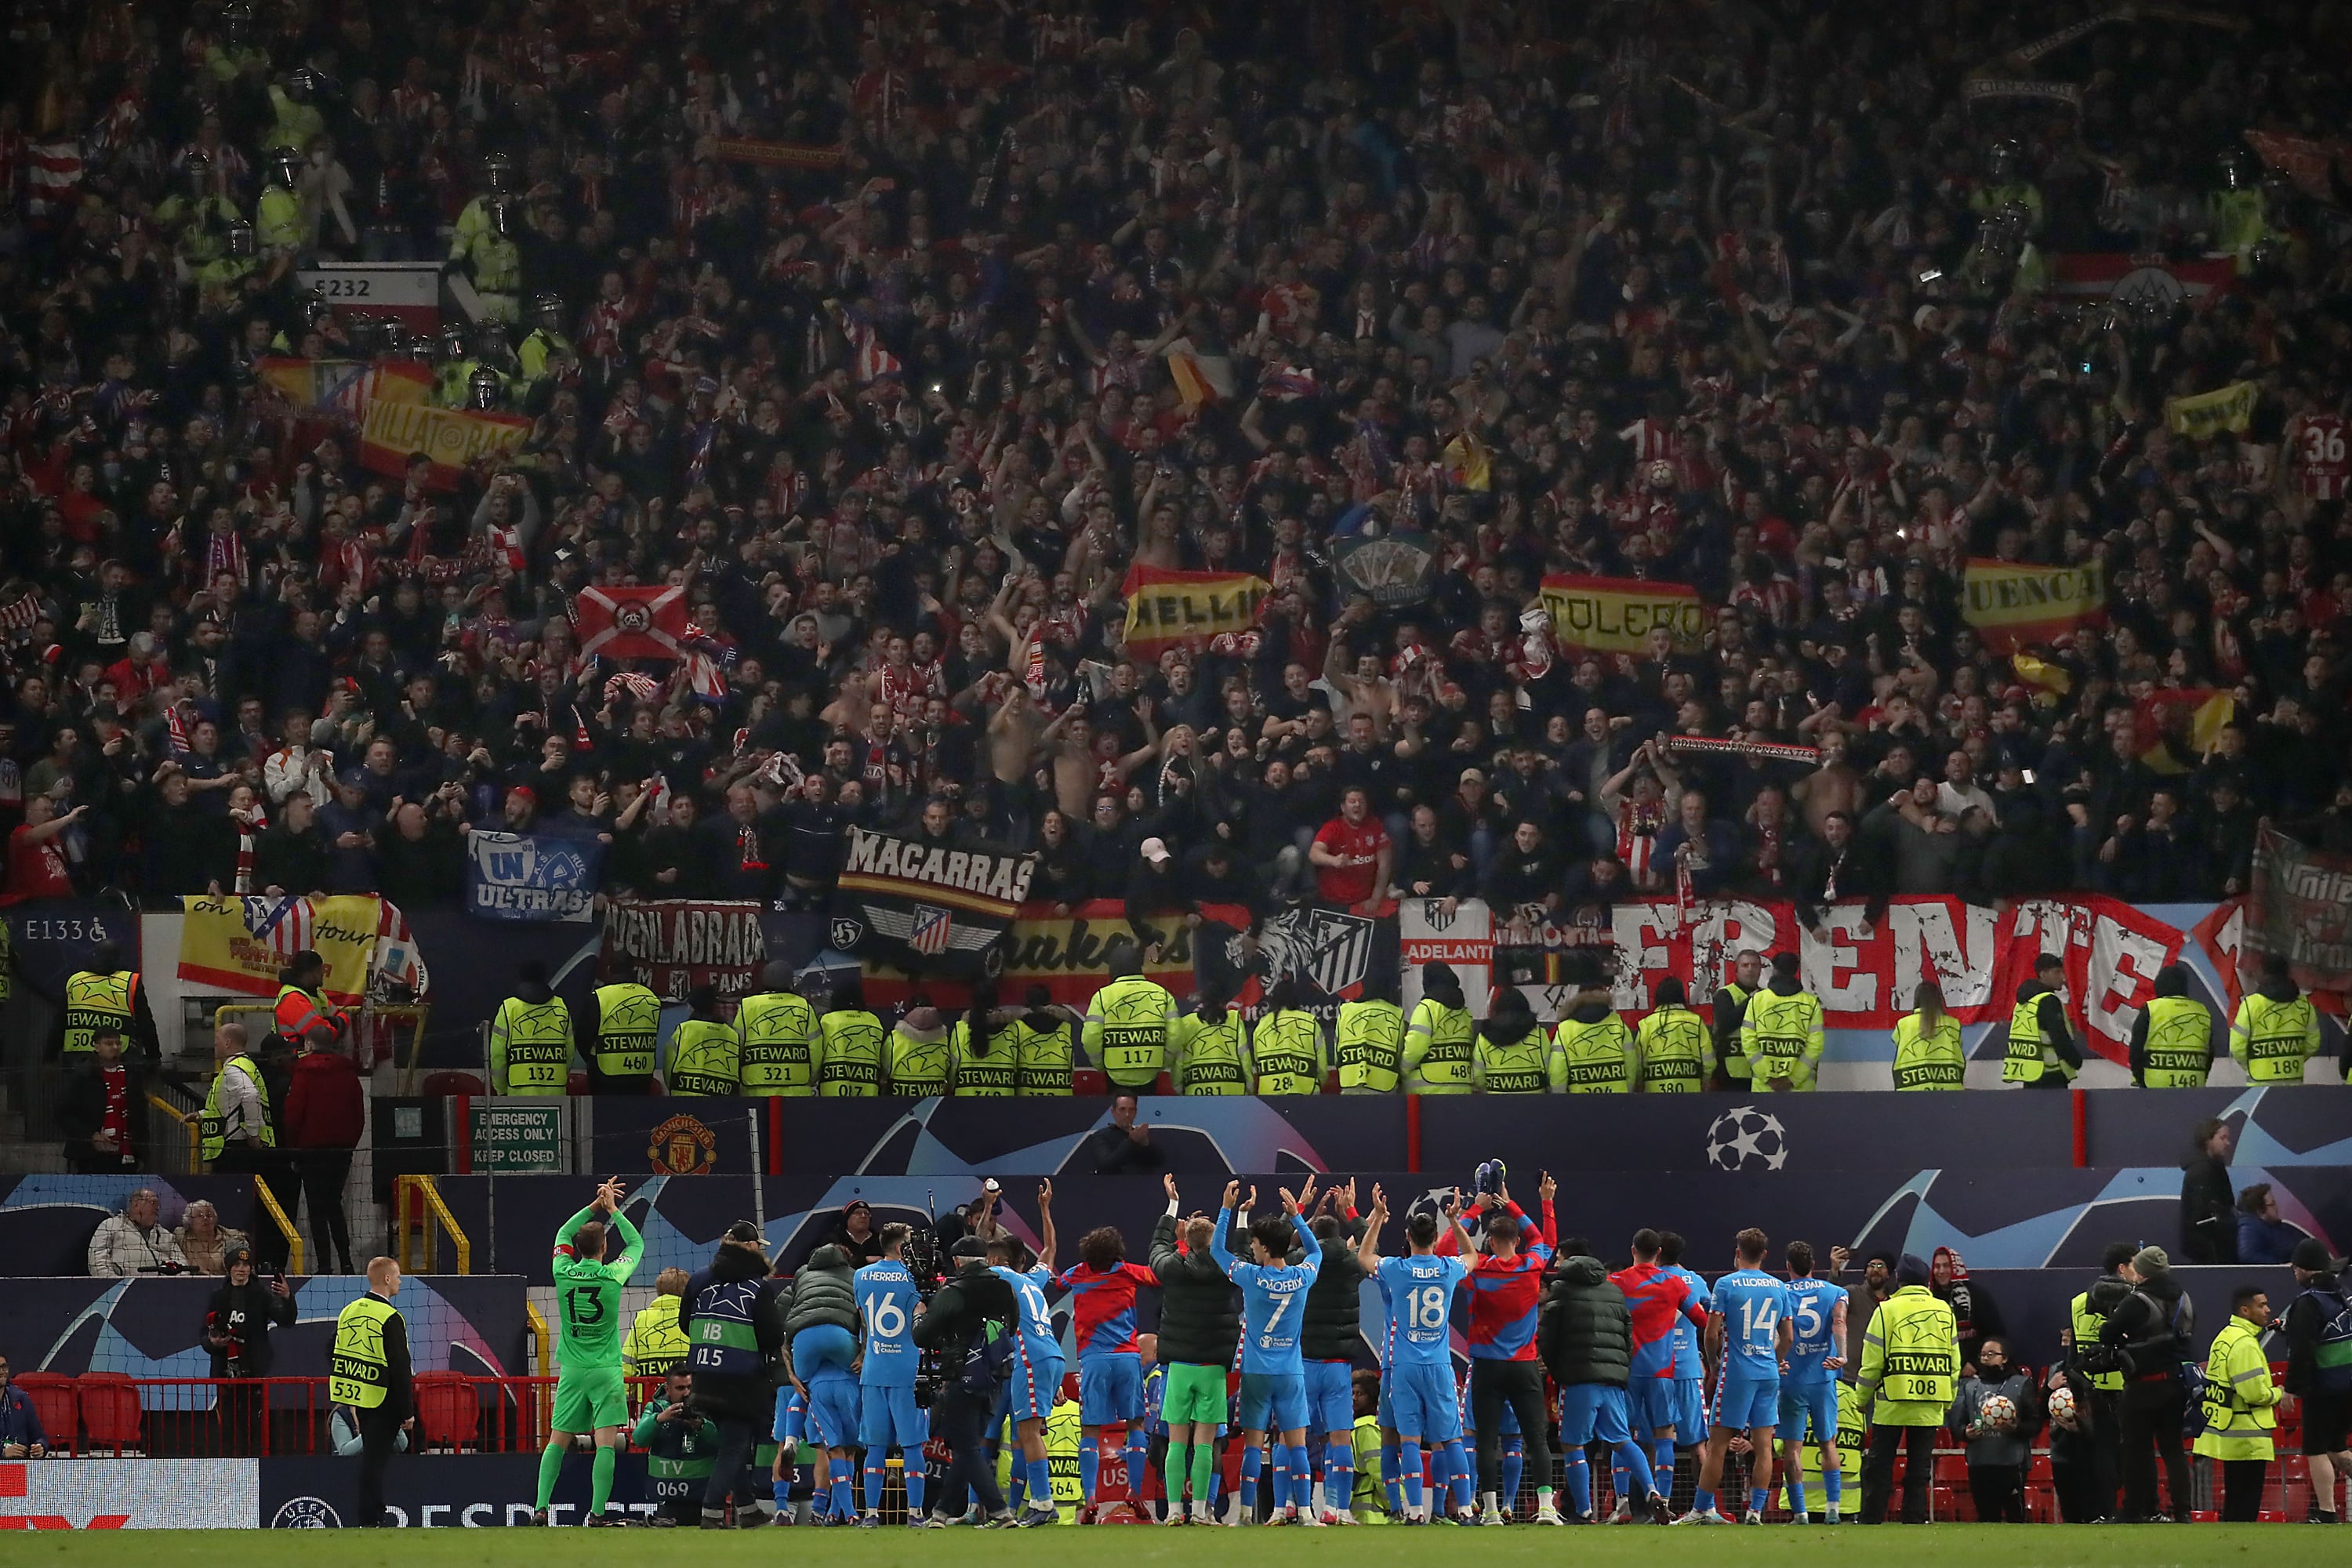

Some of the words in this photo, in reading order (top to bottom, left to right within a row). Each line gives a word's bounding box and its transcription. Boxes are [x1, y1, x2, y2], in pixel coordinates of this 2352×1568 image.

[2305, 426, 2346, 463] 36
[1544, 593, 1703, 637] TOLEDO
[847, 828, 1035, 902] MACARRAS
[477, 884, 585, 912] ULTRAS
[194, 899, 234, 916] on
[26, 920, 83, 941] E133
[315, 919, 376, 946] tour
[1612, 898, 2169, 1046] FRENTE
[709, 971, 753, 993] FANS
[67, 1012, 123, 1031] TEWARD
[604, 1036, 656, 1051] STEWARD
[622, 1056, 648, 1070] 460
[745, 1047, 808, 1062] STEWARD
[1123, 1050, 1152, 1064] 117
[528, 1066, 555, 1080] 132
[764, 1066, 791, 1080] 321
[2274, 1060, 2299, 1075] 189
[1659, 1083, 1684, 1093] 380
[2169, 1074, 2197, 1087] 148
[523, 1127, 554, 1141] ONLY
[655, 1116, 711, 1145] MANCHESTER
[509, 1149, 554, 1163] CLOSED
[869, 1271, 909, 1283] HERRERA
[1412, 1267, 1440, 1279] FELIPE
[1744, 1277, 1780, 1288] LLORENTE
[1793, 1282, 1804, 1291] DE
[1805, 1281, 1826, 1290] PAUL
[564, 1287, 604, 1324] 13
[1020, 1283, 1052, 1325] 12
[1264, 1292, 1294, 1333] 7
[1406, 1286, 1445, 1328] 18
[865, 1291, 906, 1338] 16
[1740, 1298, 1777, 1341] 14
[1797, 1295, 1822, 1338] 5
[696, 1348, 724, 1367] 015
[332, 1357, 380, 1382] EWARD
[333, 1381, 361, 1401] 532
[1907, 1379, 1936, 1396] 208
[659, 1460, 684, 1475] TV
[656, 1481, 689, 1497] 069
[285, 1501, 327, 1519] UEFA
